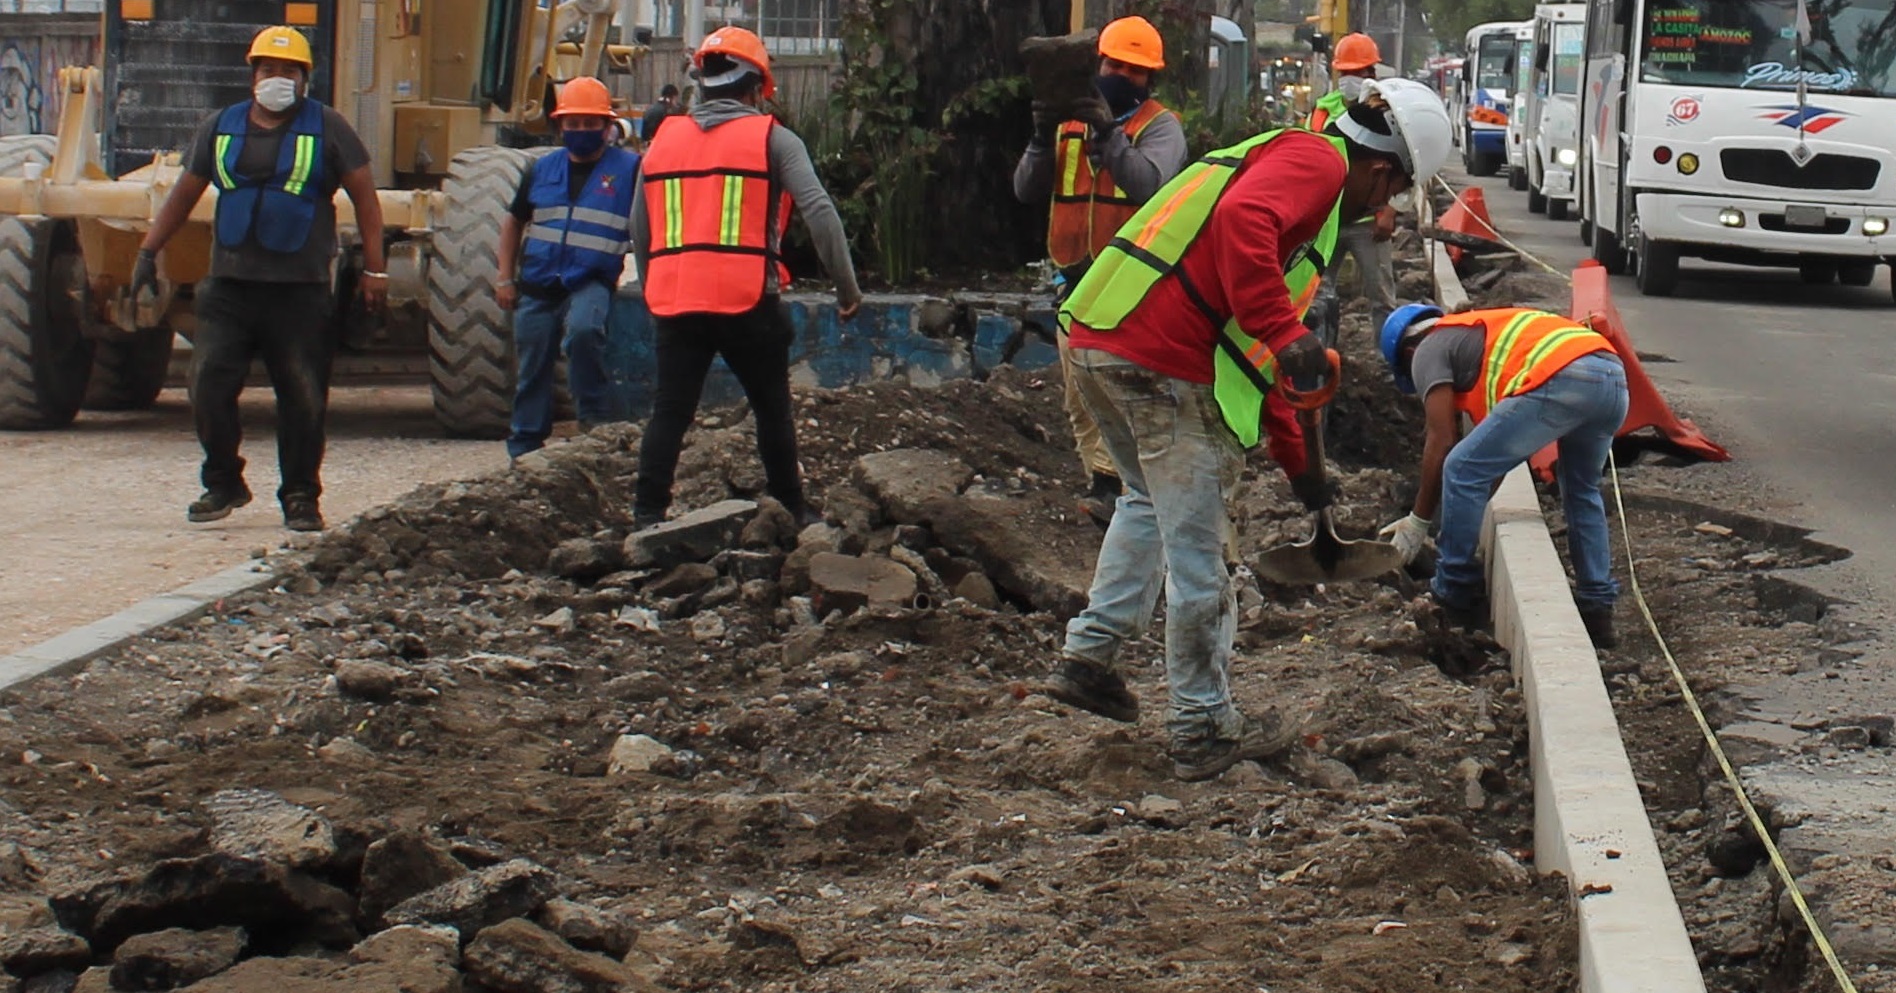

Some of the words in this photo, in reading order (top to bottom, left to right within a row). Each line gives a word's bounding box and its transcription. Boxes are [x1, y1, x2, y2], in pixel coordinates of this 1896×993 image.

[1665, 22, 1700, 34] CASITA
[1702, 27, 1752, 44] AMOZOC
[1741, 62, 1843, 89] Primos
[1676, 102, 1697, 117] 67
